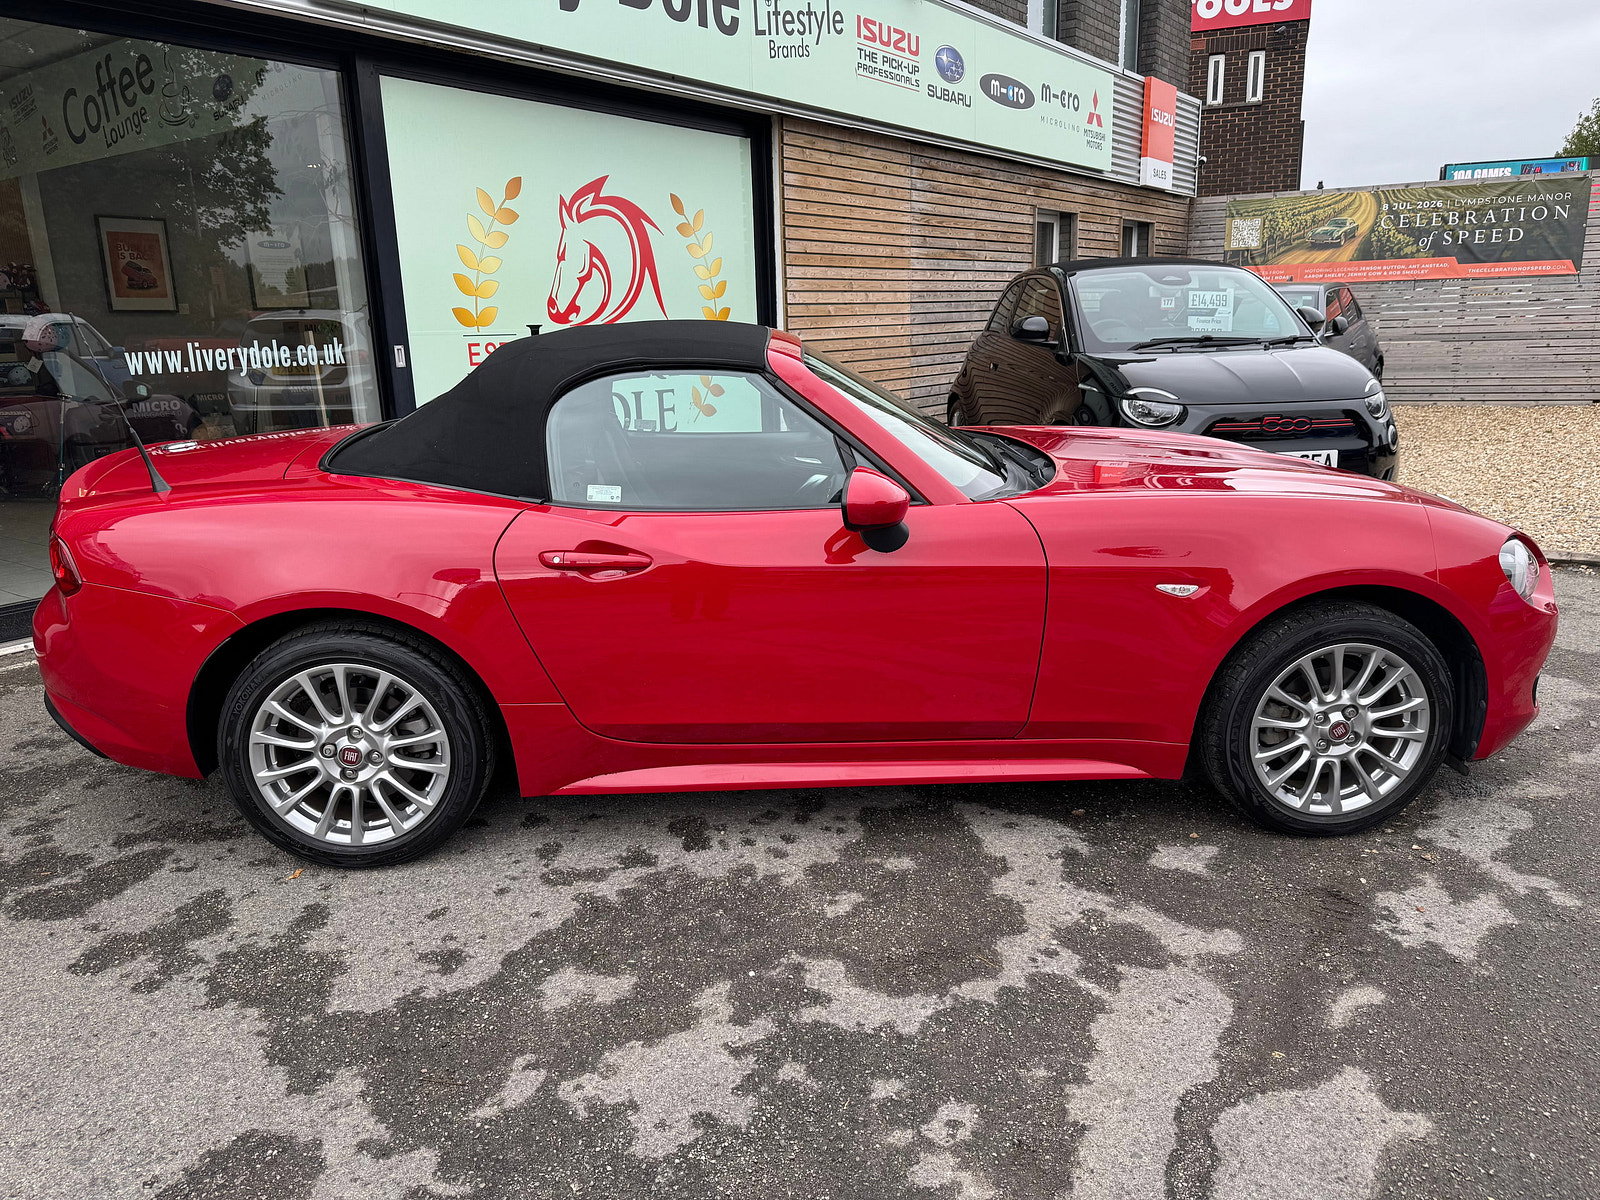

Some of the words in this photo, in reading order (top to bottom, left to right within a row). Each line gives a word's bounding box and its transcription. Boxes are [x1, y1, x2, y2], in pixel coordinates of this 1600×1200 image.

[754, 0, 844, 45] Lifestyle
[856, 14, 920, 57] ISUZU
[768, 38, 810, 59] Brands
[857, 47, 878, 64] THE
[882, 55, 920, 76] PICK-UP
[857, 62, 920, 88] PROFESSIONALS
[62, 52, 155, 145] Coffee
[927, 84, 972, 108] SUBARU
[1151, 107, 1174, 127] ISUZU
[102, 106, 149, 149] Lounge
[1083, 128, 1106, 142] MITSUBISHI
[1086, 139, 1103, 151] MOTORS
[1153, 168, 1167, 180] SALES
[1474, 167, 1512, 179] GAMES
[1382, 203, 1389, 211] 8
[1393, 202, 1412, 210] JUL
[1416, 199, 1443, 209] 2026
[1454, 195, 1523, 208] LYMPSTONE
[1527, 191, 1572, 202] MANOR
[1381, 204, 1572, 229] CELEBRATION
[1418, 230, 1438, 252] of
[1442, 227, 1525, 246] SPEED
[1162, 298, 1174, 307] 177
[1191, 293, 1228, 308] £14,499
[124, 337, 347, 377] www.liverydole.co.uk
[467, 341, 511, 367] ES
[132, 400, 182, 413] MICRO
[1262, 414, 1312, 432] 500
[1333, 725, 1346, 737] FIAT
[343, 750, 359, 762] FIAT
